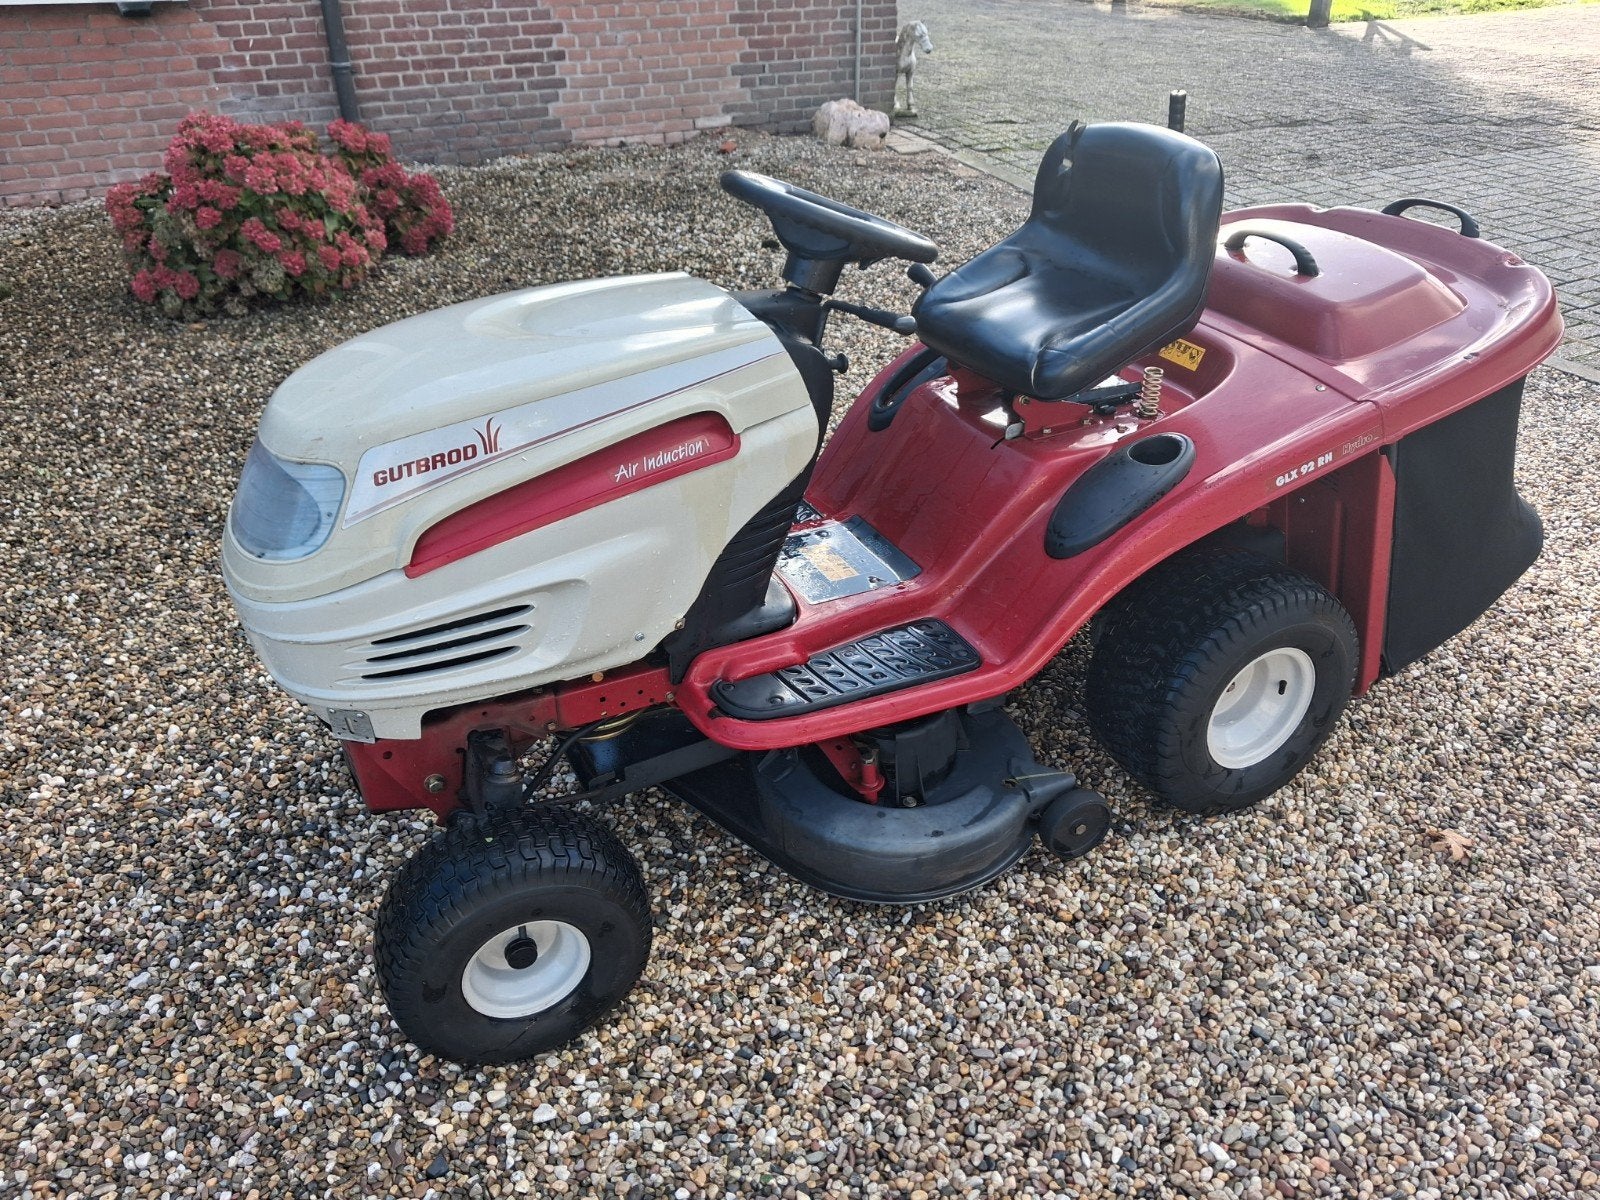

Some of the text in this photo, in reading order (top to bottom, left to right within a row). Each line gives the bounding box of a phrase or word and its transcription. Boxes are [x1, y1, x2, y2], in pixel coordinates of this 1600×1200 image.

[373, 443, 478, 487] GUTBROD
[614, 440, 703, 483] Air Induction
[1275, 434, 1373, 487] GLX 92 RH Hydro
